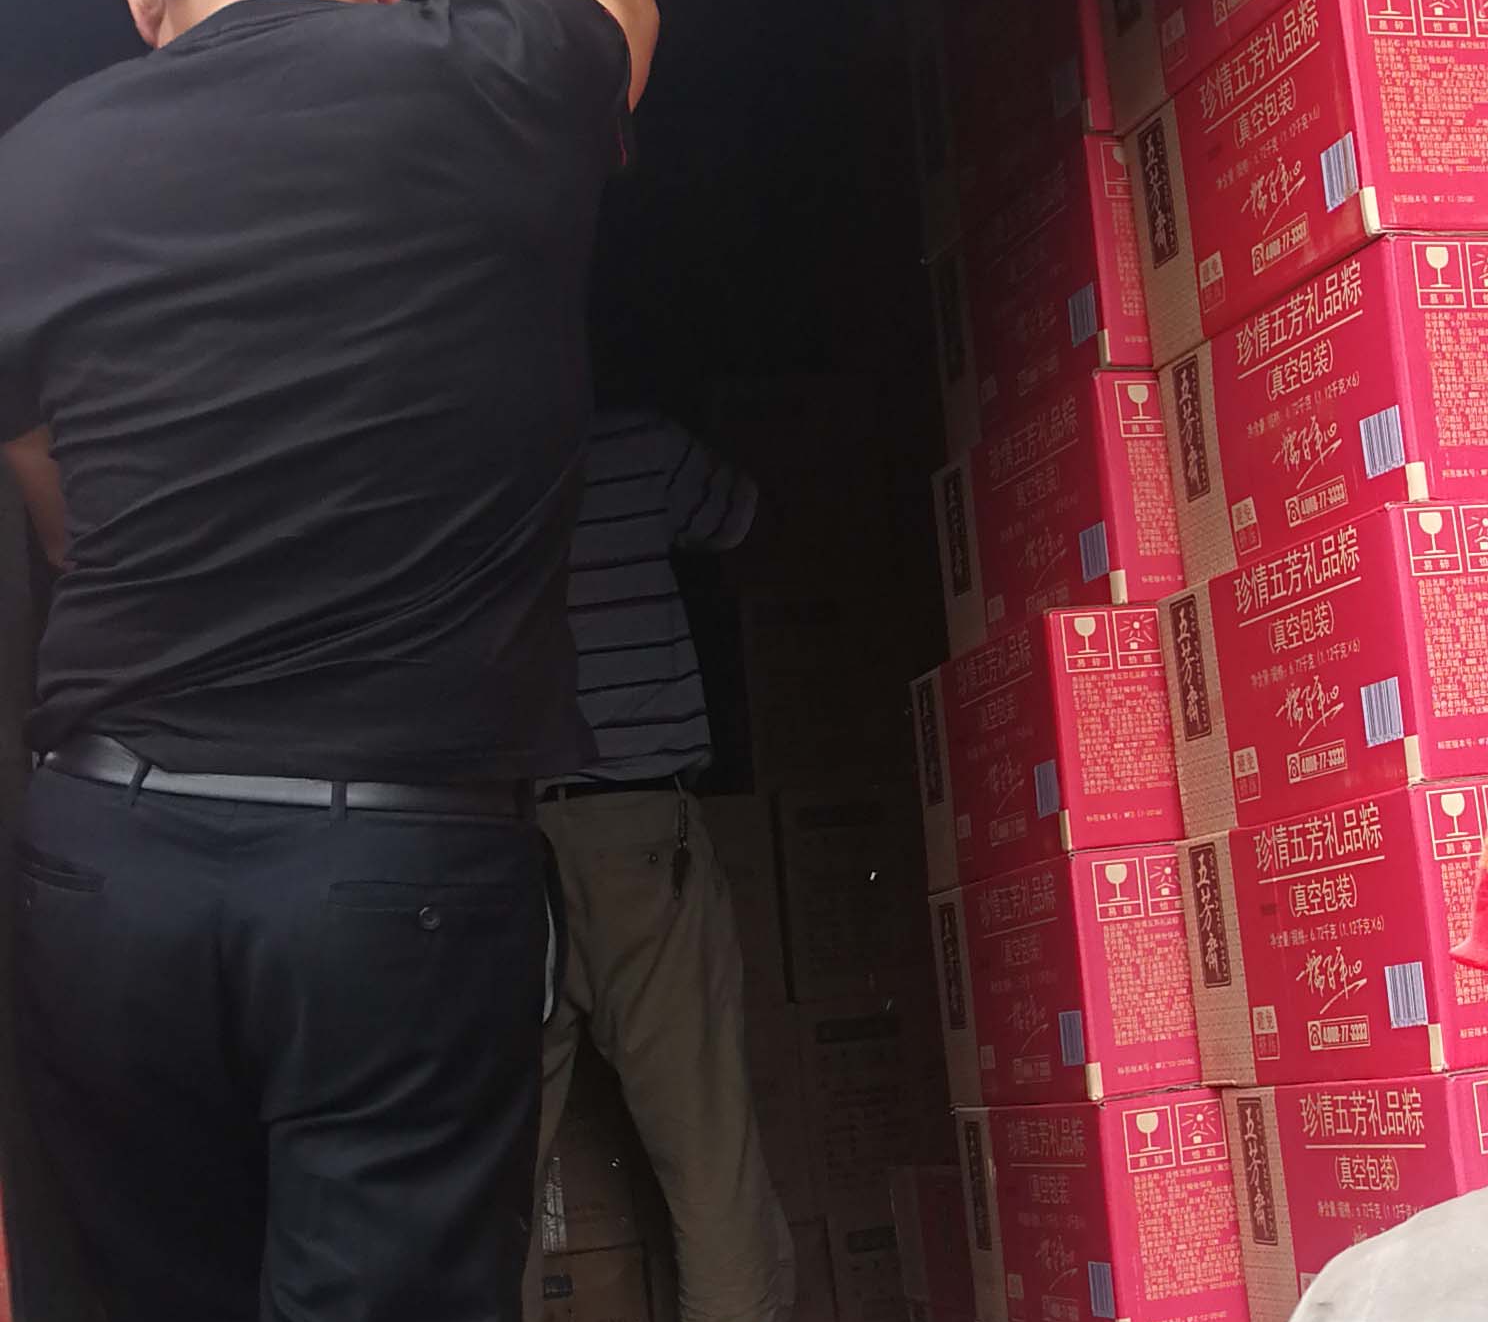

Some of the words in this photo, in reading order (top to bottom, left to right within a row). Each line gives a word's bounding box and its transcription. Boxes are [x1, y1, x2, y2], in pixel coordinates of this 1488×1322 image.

[1235, 257, 1360, 368] 珍情五芳礼品粽
[1234, 522, 1359, 616] 珍情五芳礼品粽
[1254, 799, 1382, 873] 珍情五芳礼品粽
[1299, 1086, 1424, 1139] 珍情五芳礼品粽
